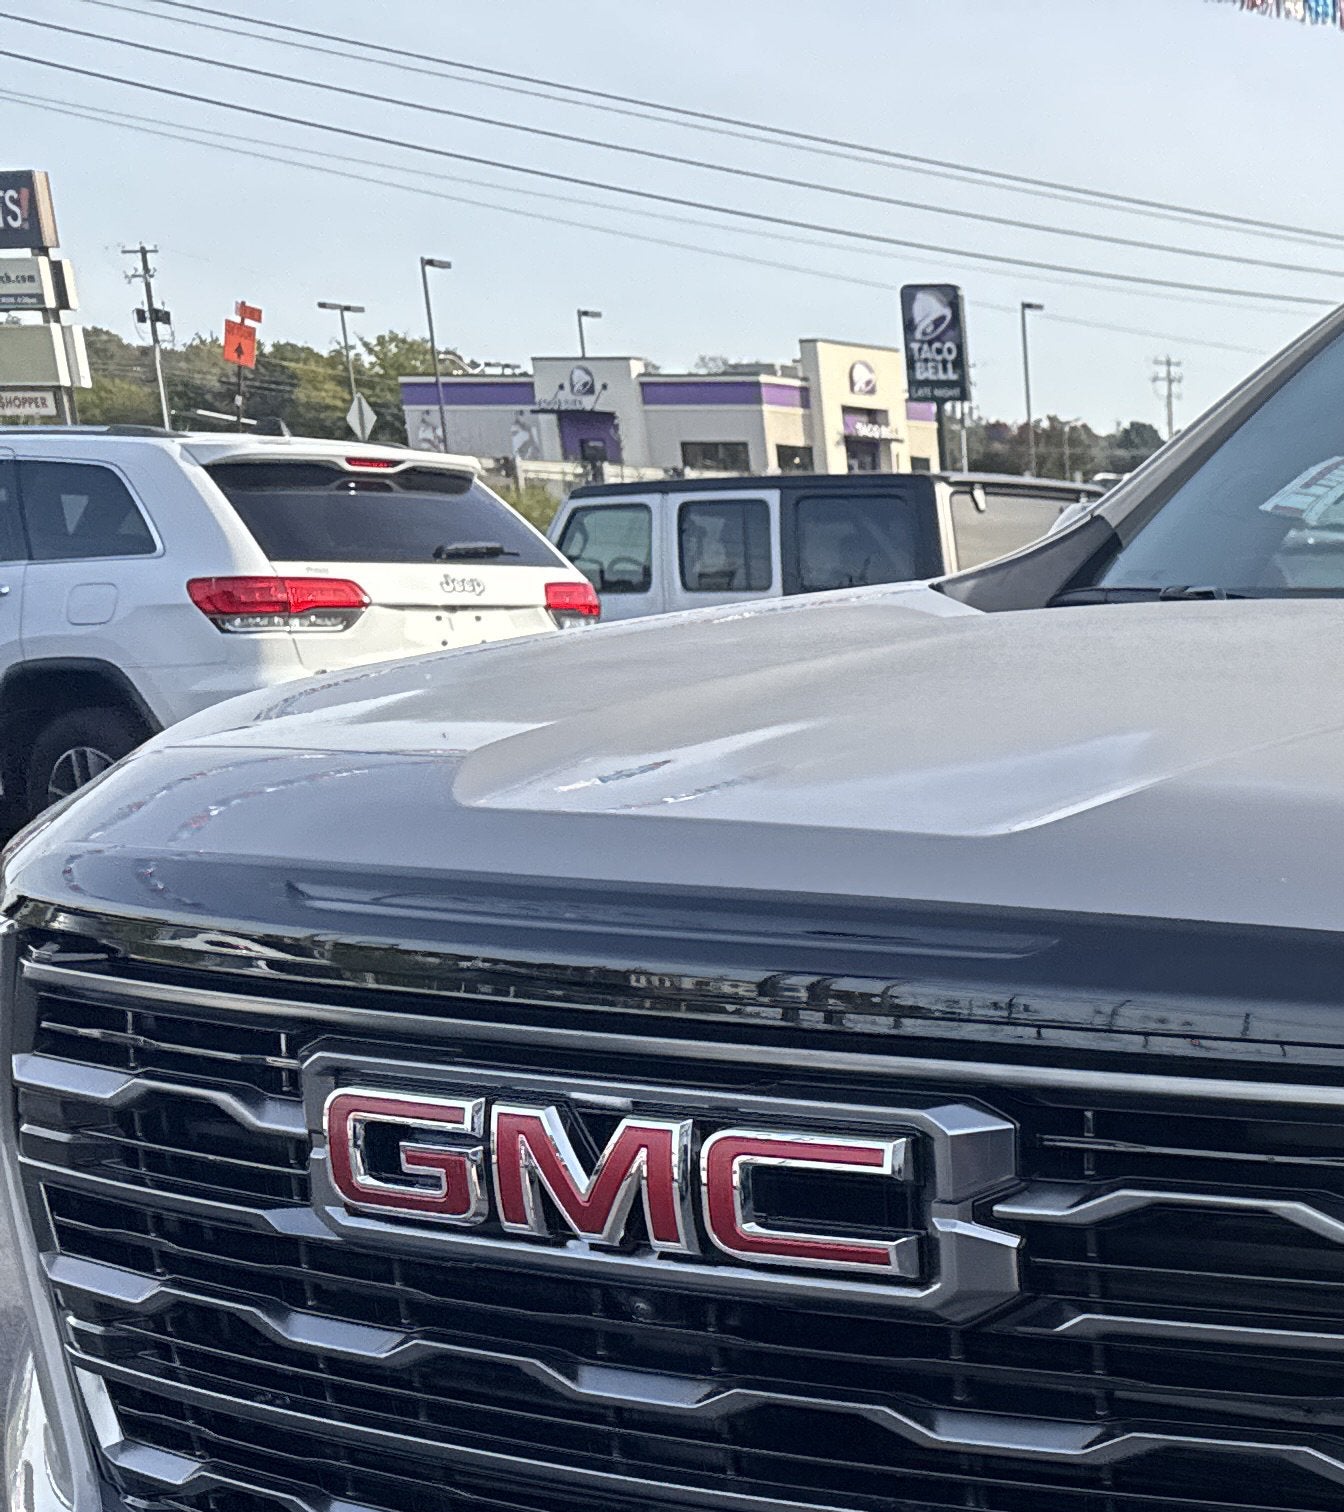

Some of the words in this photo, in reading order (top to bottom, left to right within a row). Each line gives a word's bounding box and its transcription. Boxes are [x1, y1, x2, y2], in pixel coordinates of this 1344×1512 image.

[910, 341, 957, 361] TACO
[915, 361, 959, 380] BELL
[438, 573, 486, 597] Jeep
[323, 1086, 922, 1278] GMC
